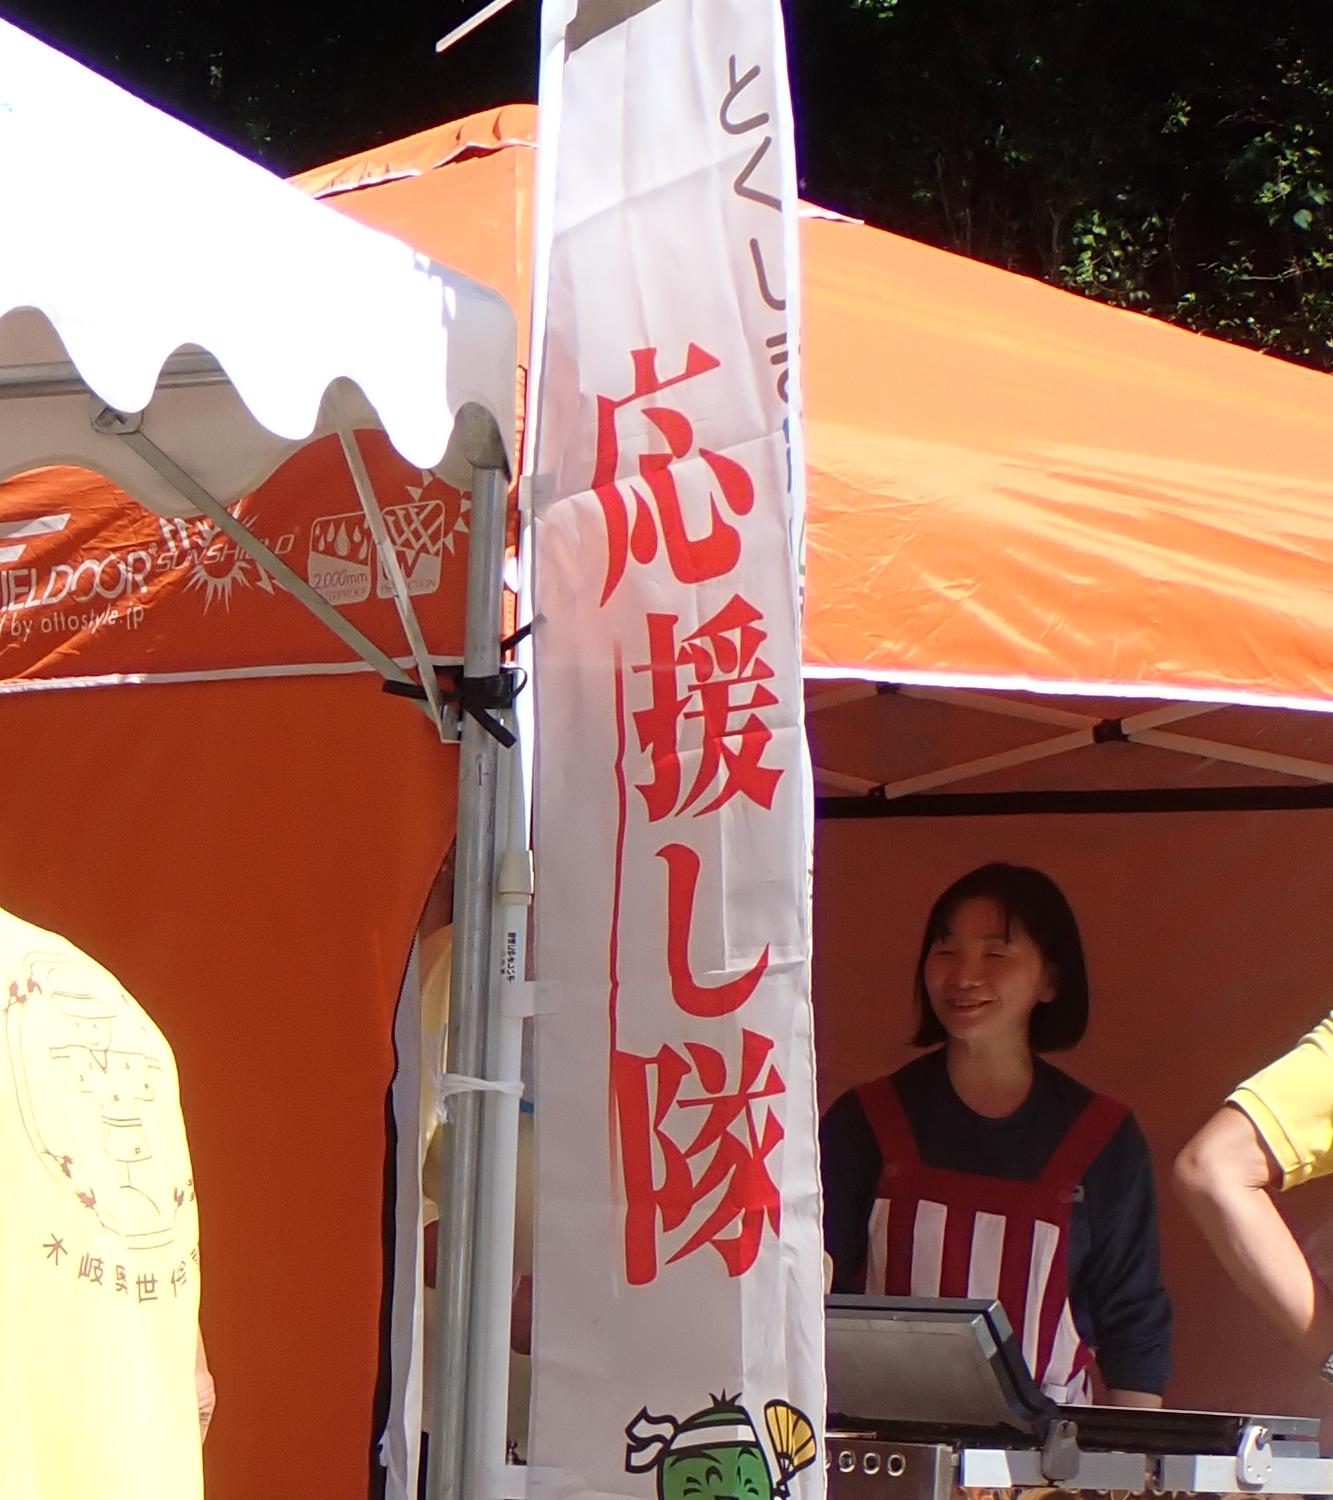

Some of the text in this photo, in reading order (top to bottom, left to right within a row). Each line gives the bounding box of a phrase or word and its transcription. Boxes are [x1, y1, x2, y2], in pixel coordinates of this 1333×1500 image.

[10, 610, 33, 642] by
[40, 601, 145, 635] ottostyle.jp
[592, 341, 786, 1286] 応援し隊
